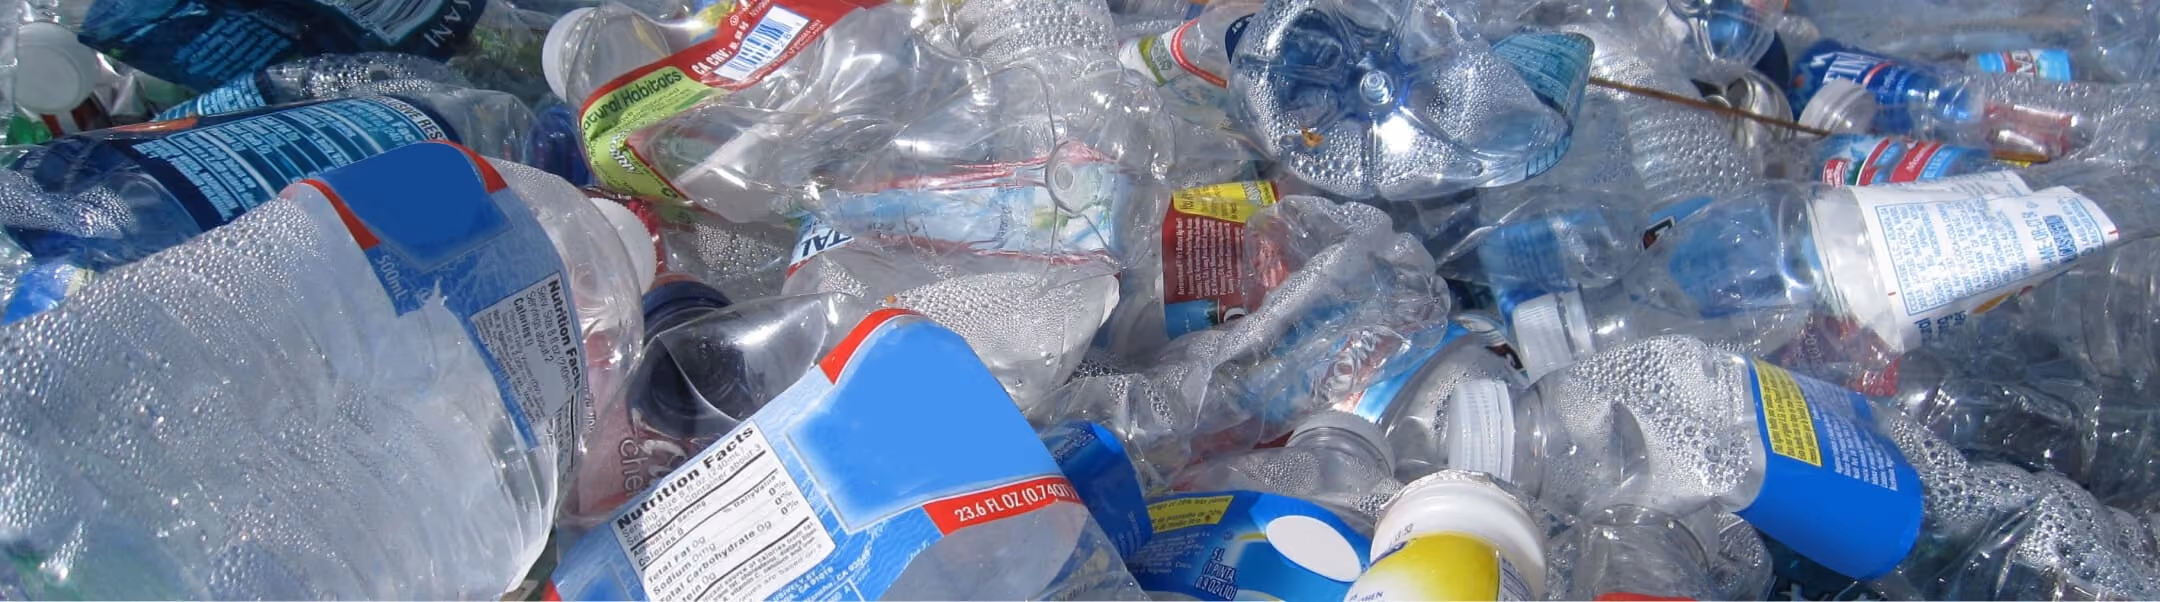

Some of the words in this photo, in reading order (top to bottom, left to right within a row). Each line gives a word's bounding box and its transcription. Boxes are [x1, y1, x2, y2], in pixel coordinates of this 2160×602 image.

[691, 61, 712, 75] CA
[583, 94, 622, 130] atural
[622, 69, 682, 107] Habitats
[418, 112, 446, 142] RES
[375, 254, 408, 301] 500mL
[512, 297, 532, 339] Calories
[547, 279, 572, 346] Nutrition
[565, 347, 582, 390] Facts
[543, 354, 554, 364] 2
[616, 468, 700, 530] Nutrition
[702, 427, 754, 469] Facts
[625, 515, 667, 547] Servings
[667, 502, 682, 517] Per
[683, 471, 727, 504] Container
[728, 449, 754, 472] about
[753, 442, 762, 452] 3
[621, 510, 658, 539] Serving
[657, 497, 678, 514] Size
[632, 534, 663, 558] Amount
[663, 523, 676, 535] Per
[677, 500, 707, 523] Serving
[954, 503, 987, 522] 23.6
[985, 497, 1004, 514] FL
[1003, 492, 1024, 511] OZ
[637, 535, 677, 568] Calories
[648, 561, 672, 584] Total
[673, 546, 691, 563] Fat
[691, 535, 707, 549] 0g
[767, 479, 786, 497] 0%
[652, 561, 692, 596] Sodium
[691, 542, 717, 562] 0mg
[773, 489, 792, 506] 0%
[685, 530, 756, 584] Carbohydrate
[755, 520, 773, 533] 0g
[780, 498, 799, 515] 0%
[701, 571, 718, 586] 0g
